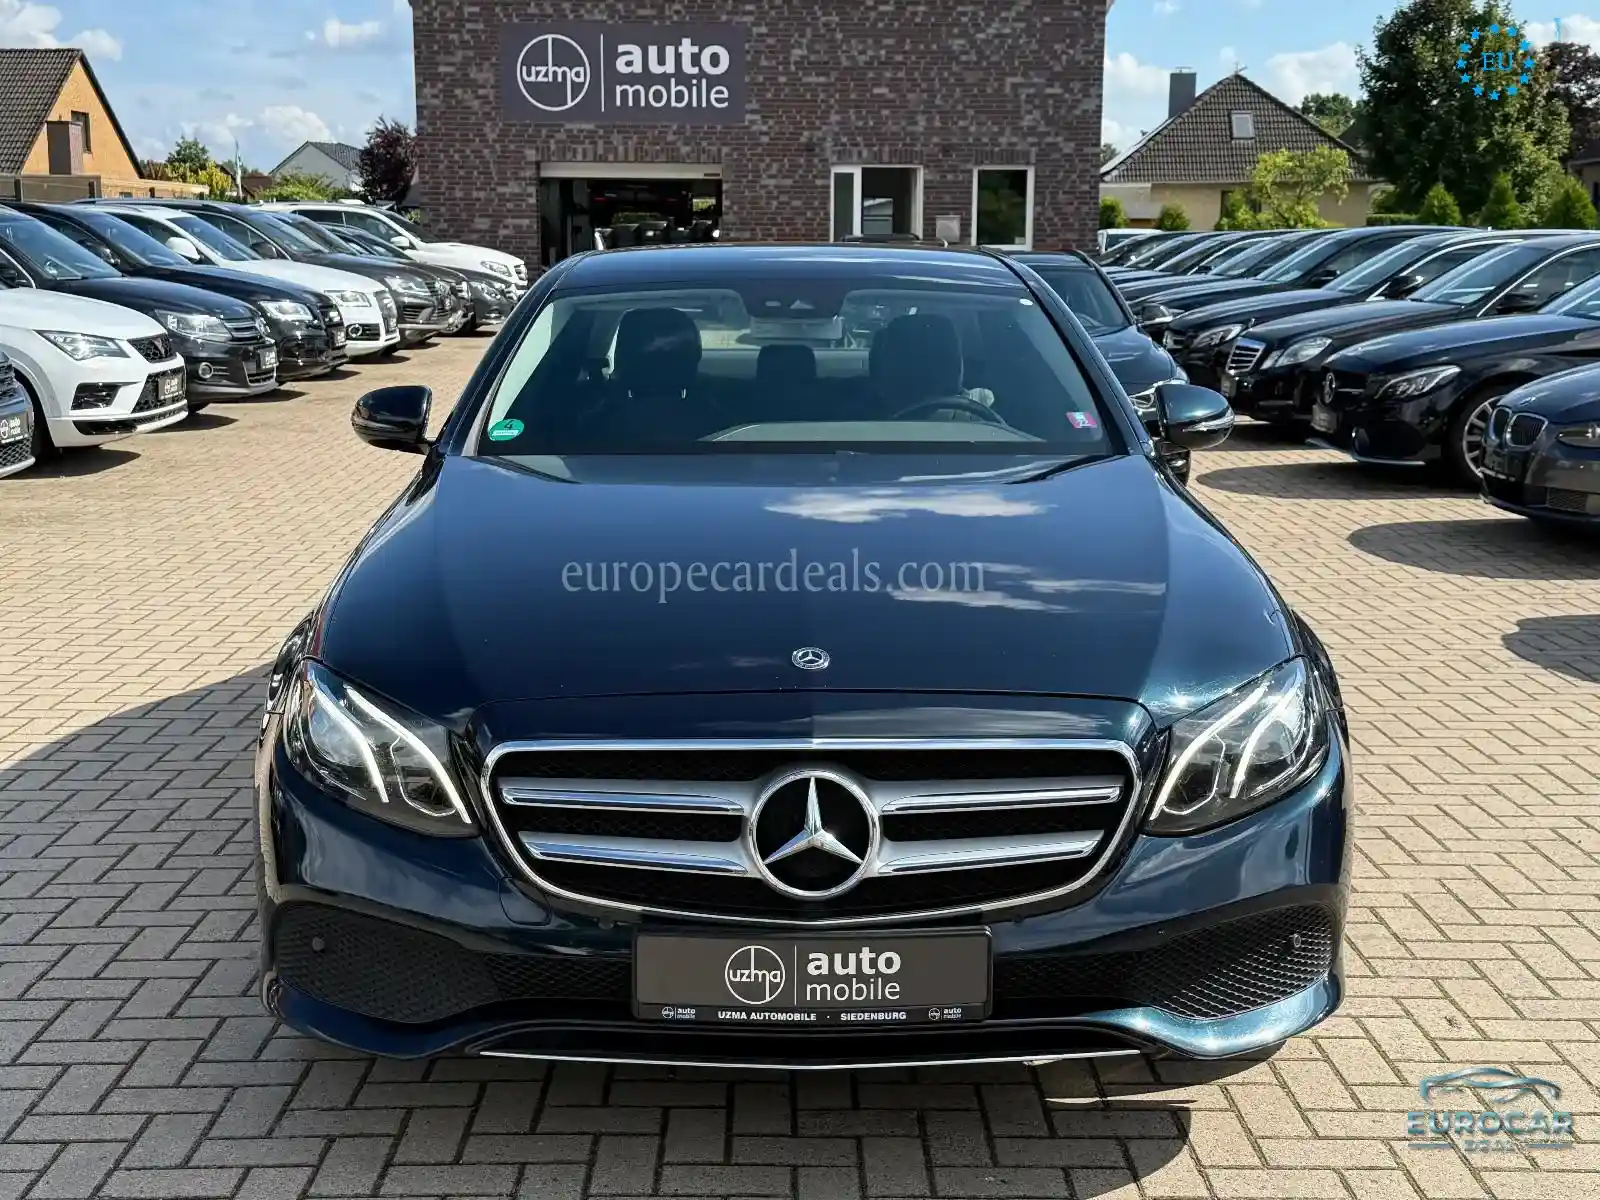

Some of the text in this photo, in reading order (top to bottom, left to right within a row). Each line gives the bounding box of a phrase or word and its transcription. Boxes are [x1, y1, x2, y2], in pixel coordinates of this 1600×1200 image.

[615, 37, 730, 75] auto
[521, 64, 585, 83] uzma
[615, 78, 729, 108] mobile
[806, 946, 901, 976] auto
[729, 967, 782, 984] uzma
[806, 977, 901, 1001] mobile
[677, 1006, 696, 1014] auto
[717, 1010, 907, 1021] UZMA AUTOMOBILE SIEDENBURG
